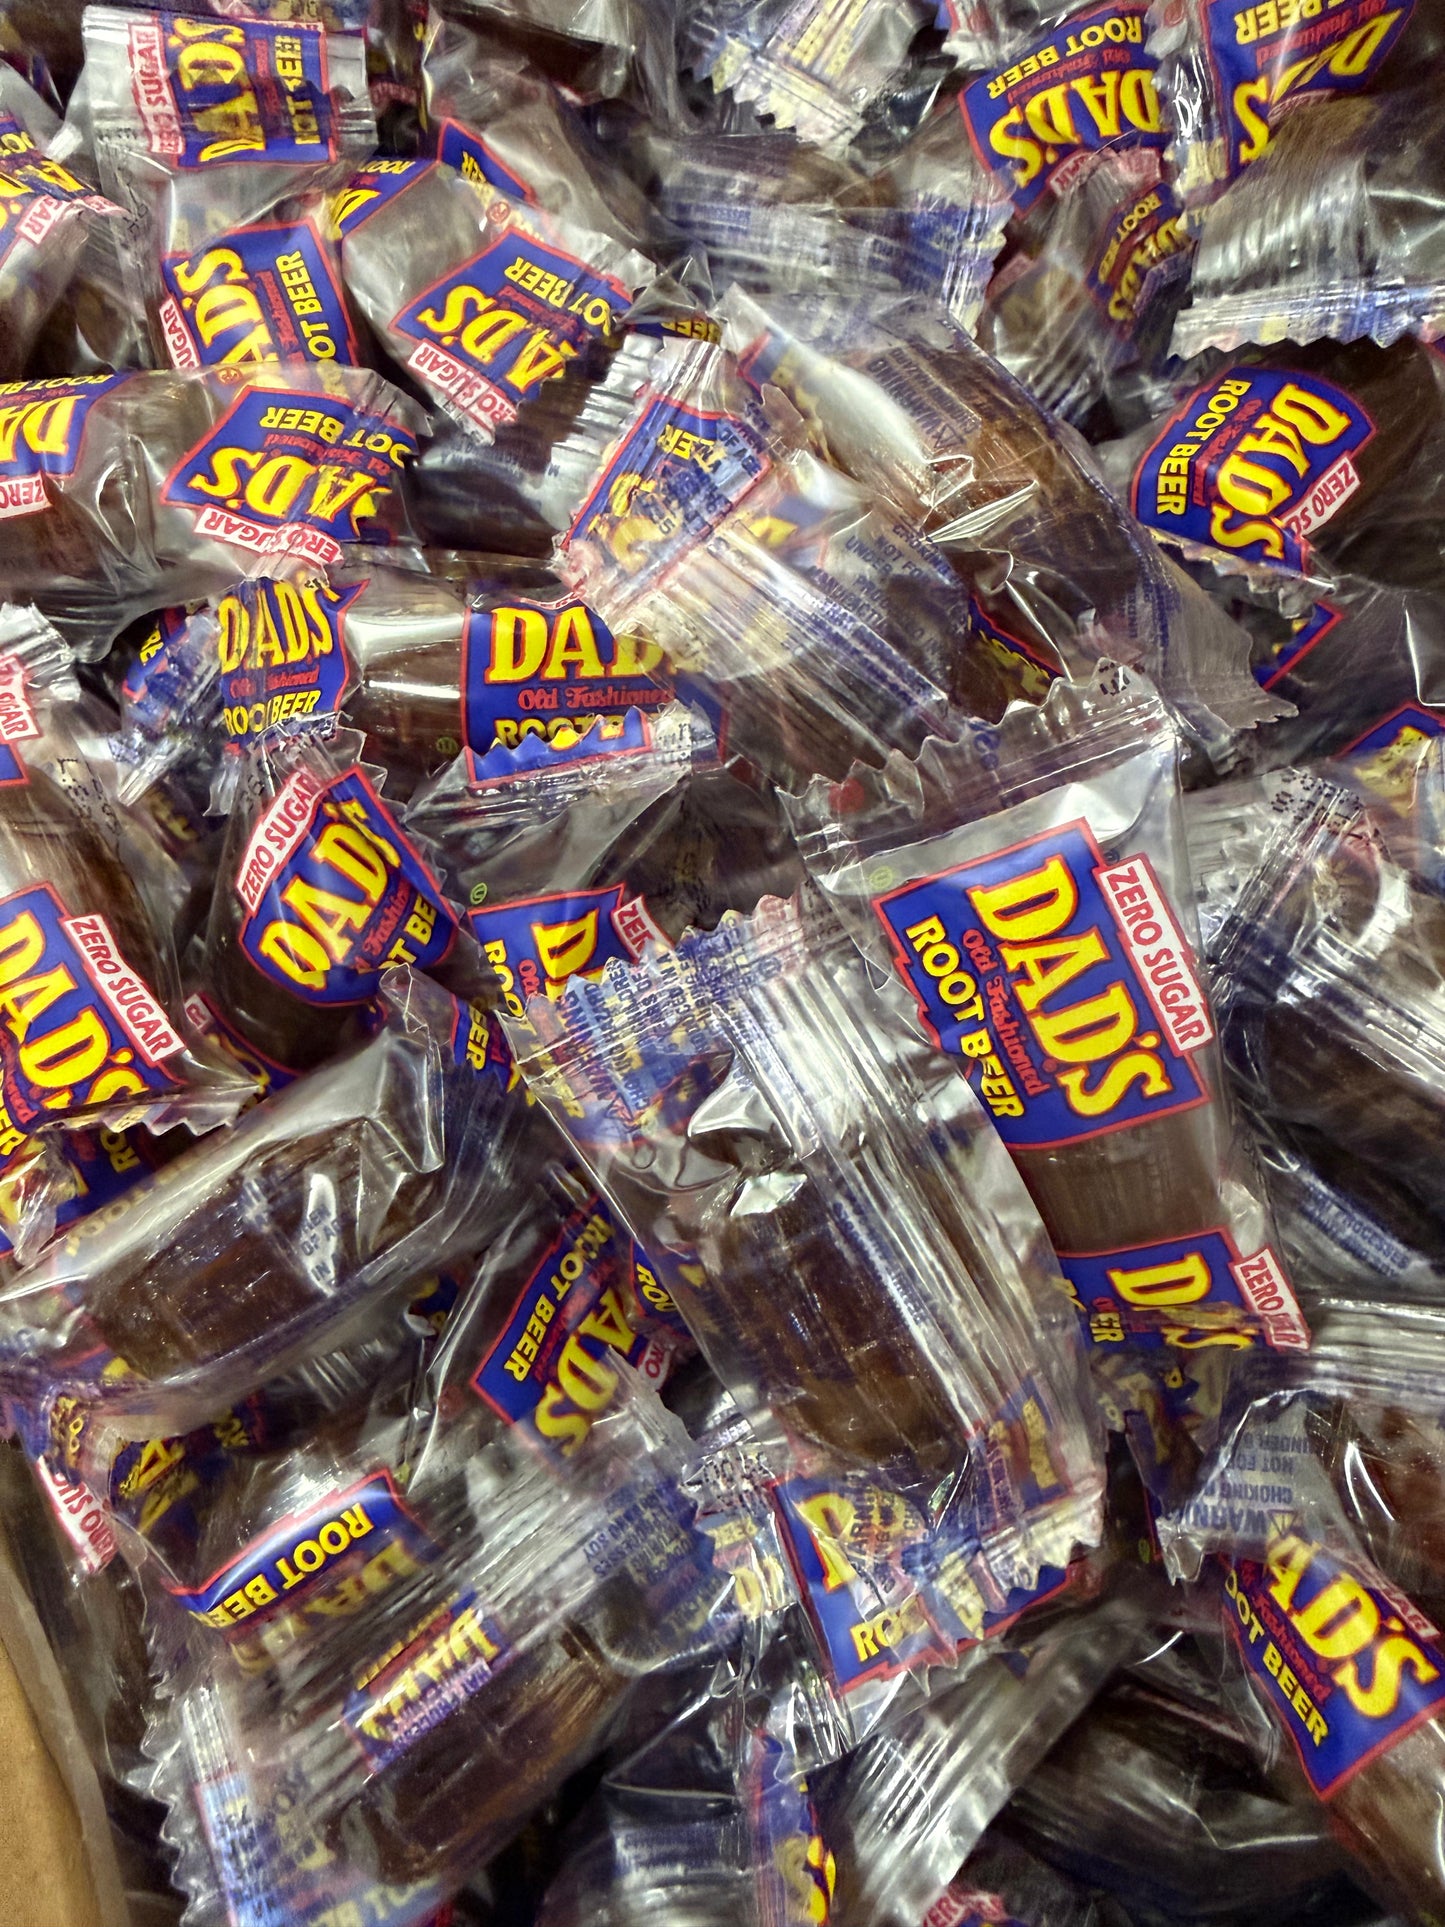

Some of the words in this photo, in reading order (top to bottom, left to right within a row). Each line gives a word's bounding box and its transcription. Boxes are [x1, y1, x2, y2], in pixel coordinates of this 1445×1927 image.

[987, 45, 1060, 99] BEER
[1065, 16, 1142, 56] ROOT
[989, 69, 1162, 188] DAD'S
[173, 248, 279, 363] AD'S
[275, 250, 323, 316] BEER
[504, 256, 575, 309] BEER
[415, 346, 481, 399] SUGAR
[416, 284, 580, 394] AD'S
[259, 407, 344, 444] BEER
[1186, 378, 1252, 441] ROOT
[188, 447, 392, 537] AD'S
[1157, 444, 1201, 516] BEER
[1210, 383, 1351, 560] DAD'S
[1313, 463, 1355, 516] ZERO
[287, 523, 341, 563] ERO
[872, 534, 903, 563] NOT
[485, 606, 666, 683] DAD
[271, 690, 322, 724] BEER
[518, 688, 559, 710] Old
[241, 845, 275, 906] ZERO
[265, 775, 318, 850] SUGAR
[259, 797, 401, 991] DAD'S
[70, 918, 122, 975] ZERO
[107, 976, 174, 1056] SUGAR
[484, 940, 525, 1018] ROO
[965, 853, 1175, 1119] DAD'S
[1106, 867, 1163, 947] ZERO
[1143, 945, 1207, 1046] SUGAR
[0, 911, 149, 1110] DAD'S
[905, 914, 985, 1022] ROOT
[960, 1028, 1026, 1118] BEER
[963, 928, 997, 973] Old
[985, 975, 1049, 1097] Fashioned
[101, 1127, 141, 1174] RO
[1240, 1256, 1284, 1312] ZERO
[504, 1294, 556, 1383] BEER
[534, 1287, 638, 1458] ADS
[275, 1502, 374, 1590] ROOT
[1193, 1504, 1268, 1535] WARN
[1225, 1568, 1265, 1644] OOT
[1263, 1642, 1329, 1748] BEER
[1268, 1535, 1441, 1718] AD'S
